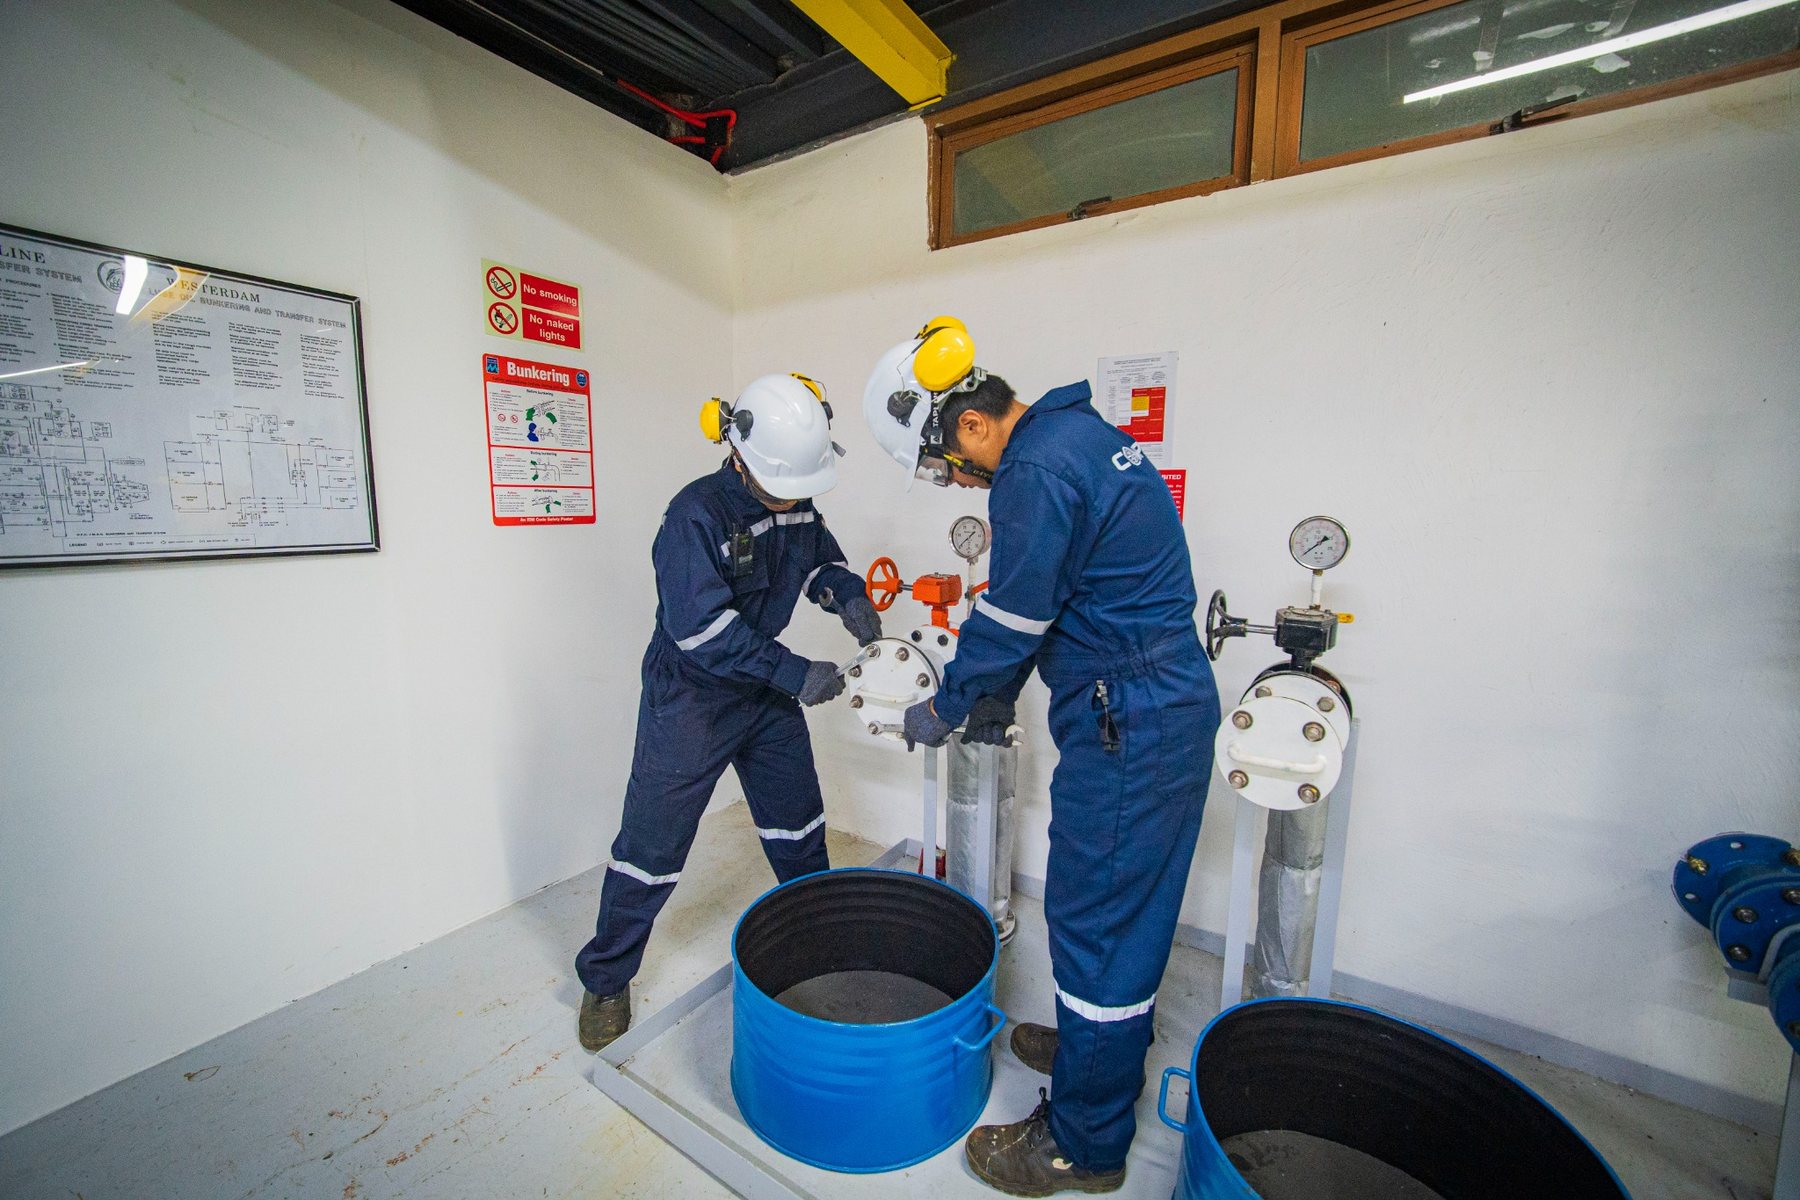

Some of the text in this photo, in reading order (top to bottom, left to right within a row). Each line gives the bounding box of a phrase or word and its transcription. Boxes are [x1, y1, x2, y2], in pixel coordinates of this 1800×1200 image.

[0, 244, 46, 264] LINE
[35, 267, 83, 284] SYSTEM
[523, 283, 578, 306] No smoking
[199, 297, 251, 312] BUNKERING
[254, 306, 272, 315] AND
[274, 309, 314, 323] TRANSFER
[318, 318, 347, 329] SYSTEM
[529, 313, 574, 332] No naked
[539, 329, 566, 342] lights
[506, 361, 570, 387] Bunkering
